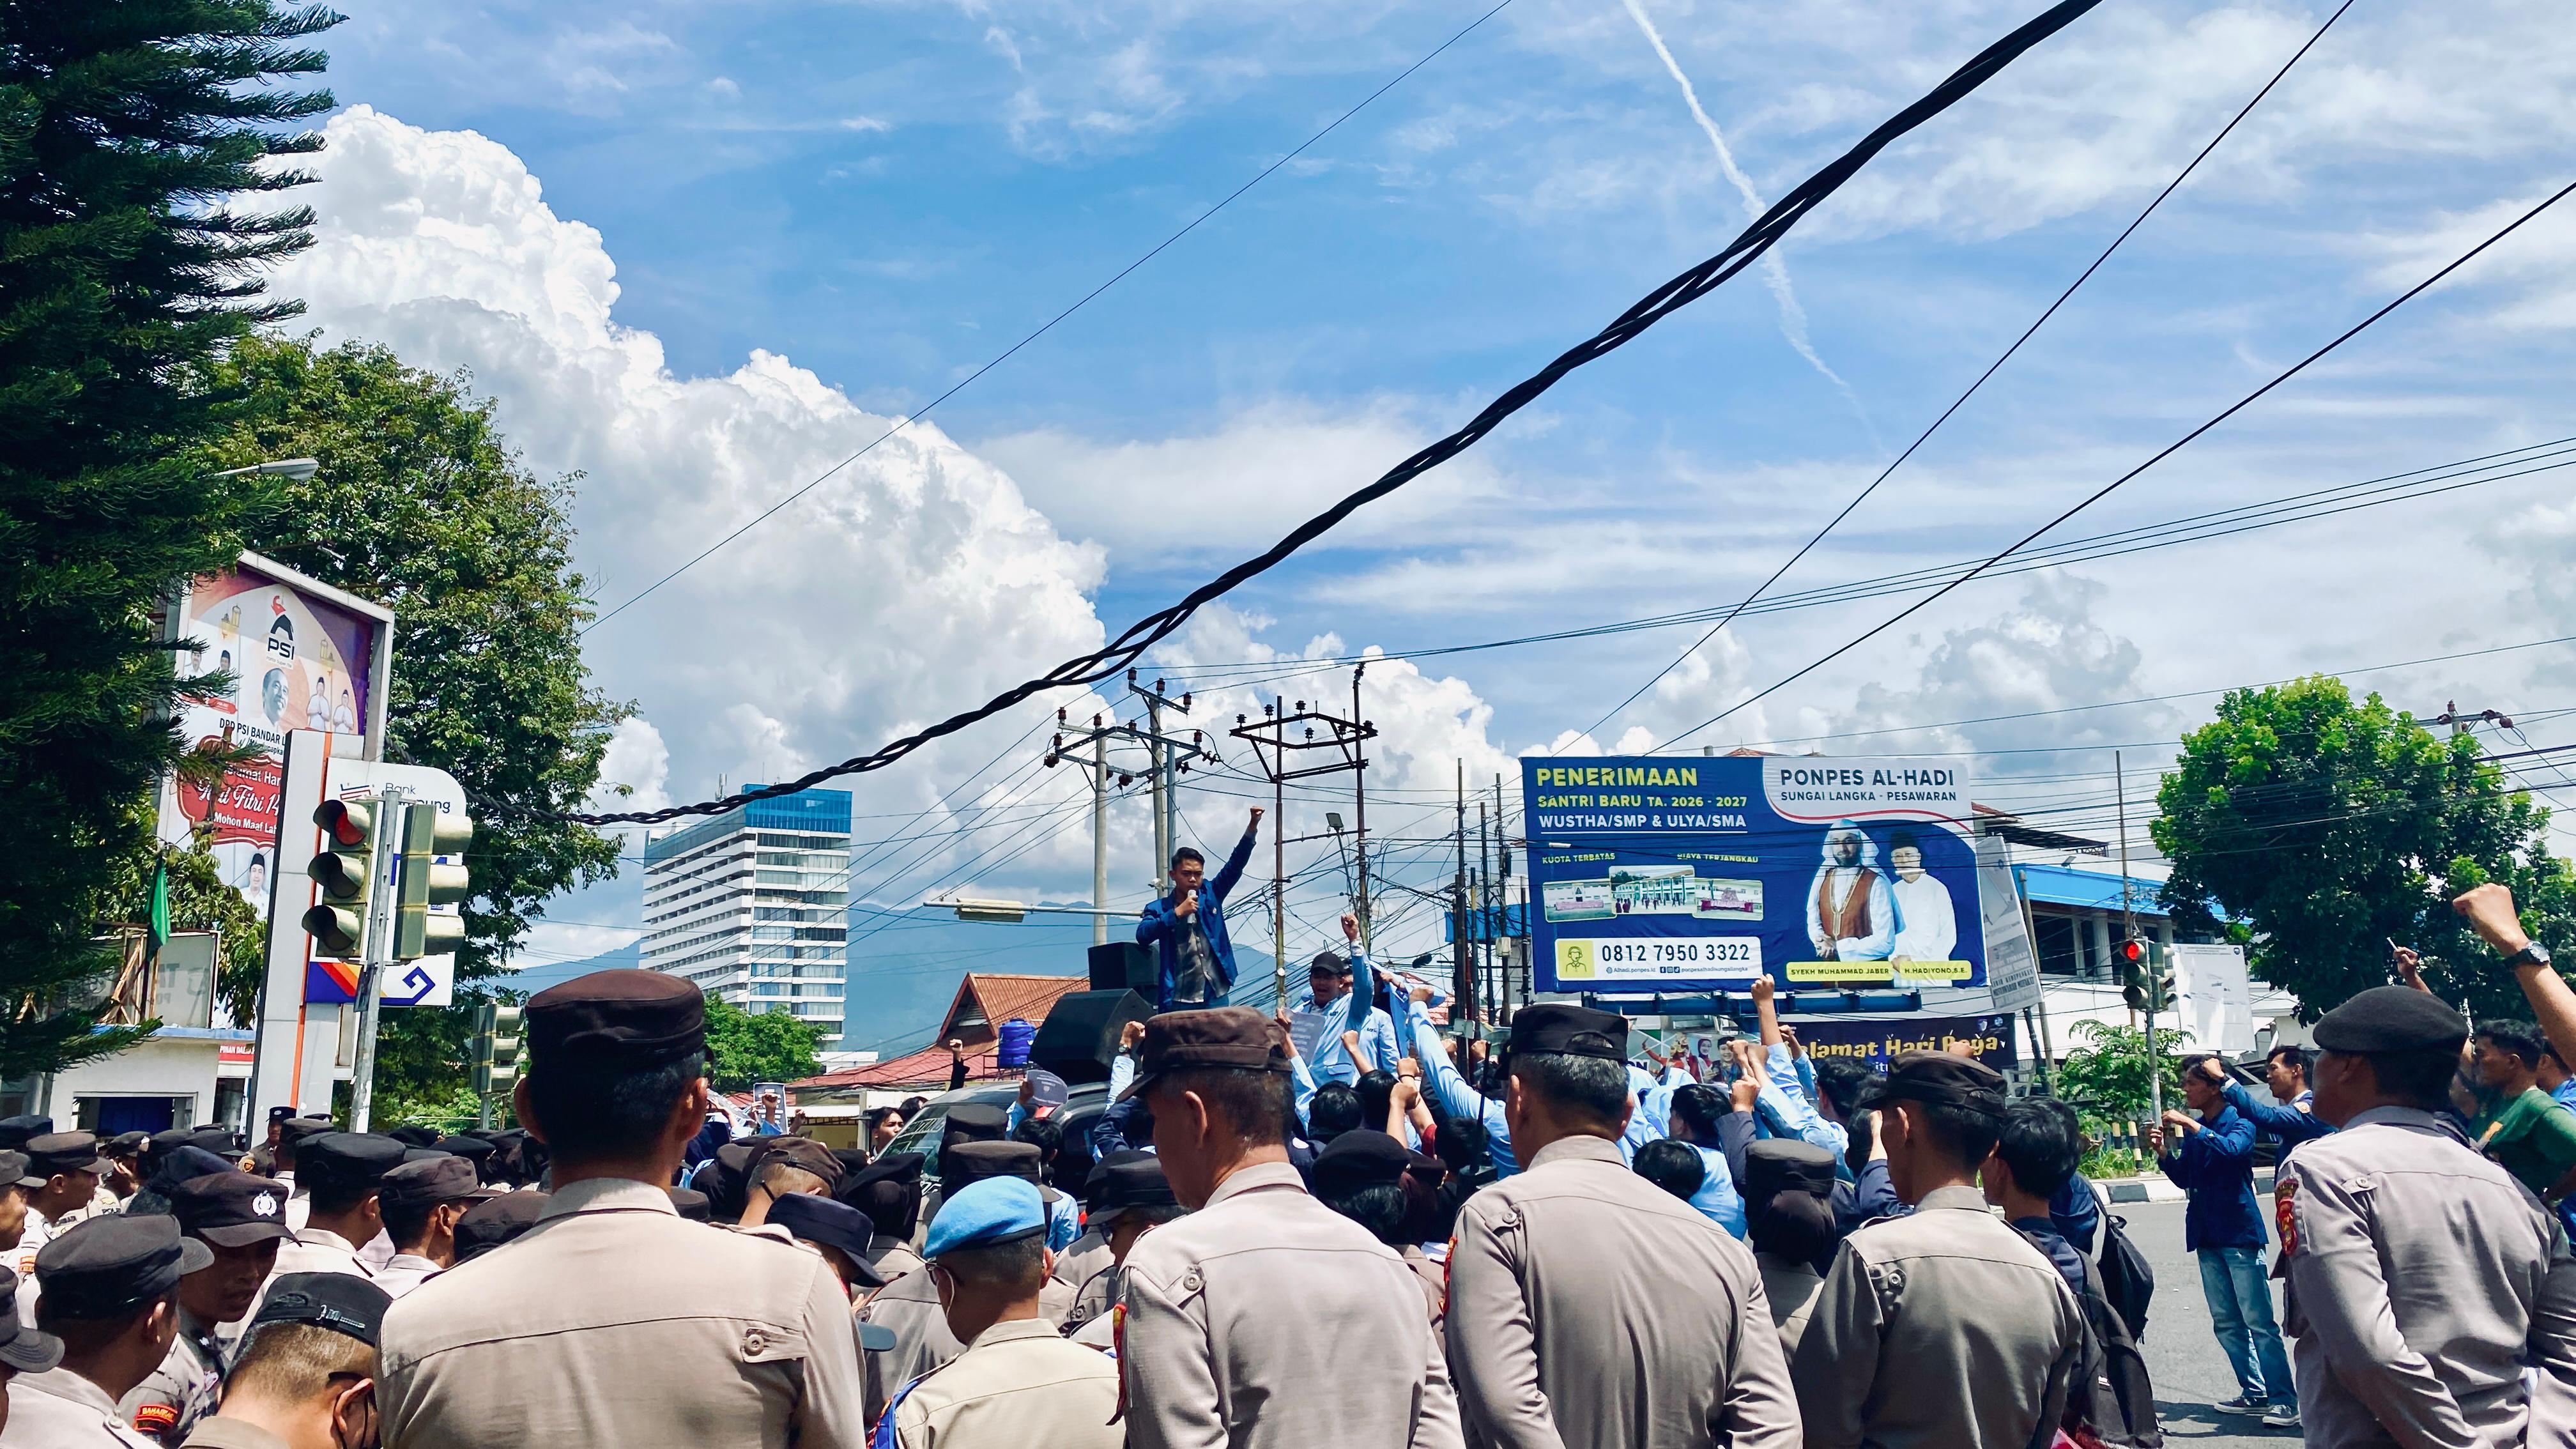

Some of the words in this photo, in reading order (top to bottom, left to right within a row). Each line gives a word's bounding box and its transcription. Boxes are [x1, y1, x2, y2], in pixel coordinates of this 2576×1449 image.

[268, 637, 295, 660] PSI
[237, 723, 249, 735] PSI
[251, 727, 280, 745] BANDAR
[1537, 767, 1698, 786] PENERIMAAN
[1781, 769, 1864, 786] PONPES
[1872, 769, 1954, 786] AL-HADI
[233, 784, 264, 813] Fitri
[1538, 795, 1593, 808] SANTRI
[1600, 795, 1641, 808] BARU
[1647, 797, 1667, 808] TA.
[1671, 796, 1704, 807] 2026
[1716, 796, 1747, 807] 2027
[1781, 792, 1825, 801] SUNGAI
[1829, 792, 1876, 801] LANGKA
[1887, 792, 1956, 801] PESAWARAN
[213, 812, 241, 827] Mohon
[242, 818, 264, 832] Maaf
[1538, 814, 1647, 829] WUSTHA/SMP
[1652, 815, 1662, 827] &
[1667, 814, 1747, 828] ULYA/SMA
[1542, 855, 1570, 864] KUOTA
[1573, 852, 1616, 863] TERBATAS
[1602, 945, 1646, 962] 0812
[1653, 944, 1698, 962] 7950
[1705, 944, 1750, 961] 3322
[1886, 1036, 1934, 1056] Hari
